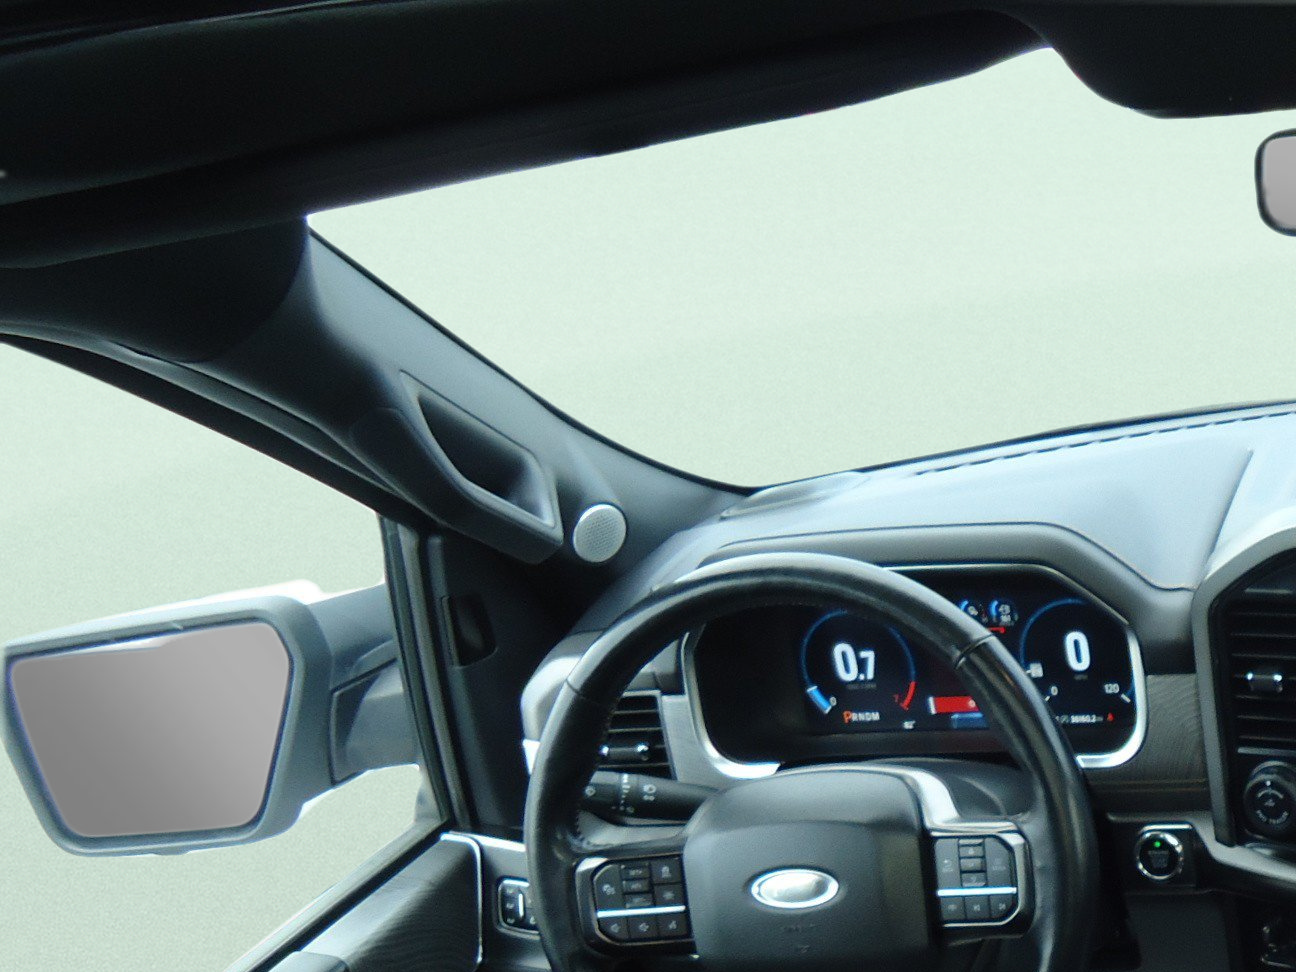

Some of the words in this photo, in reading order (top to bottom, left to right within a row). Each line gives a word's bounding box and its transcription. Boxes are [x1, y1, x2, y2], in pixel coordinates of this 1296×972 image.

[833, 642, 876, 682] 0.7
[1065, 631, 1091, 672] 0
[1104, 683, 1120, 694] 120
